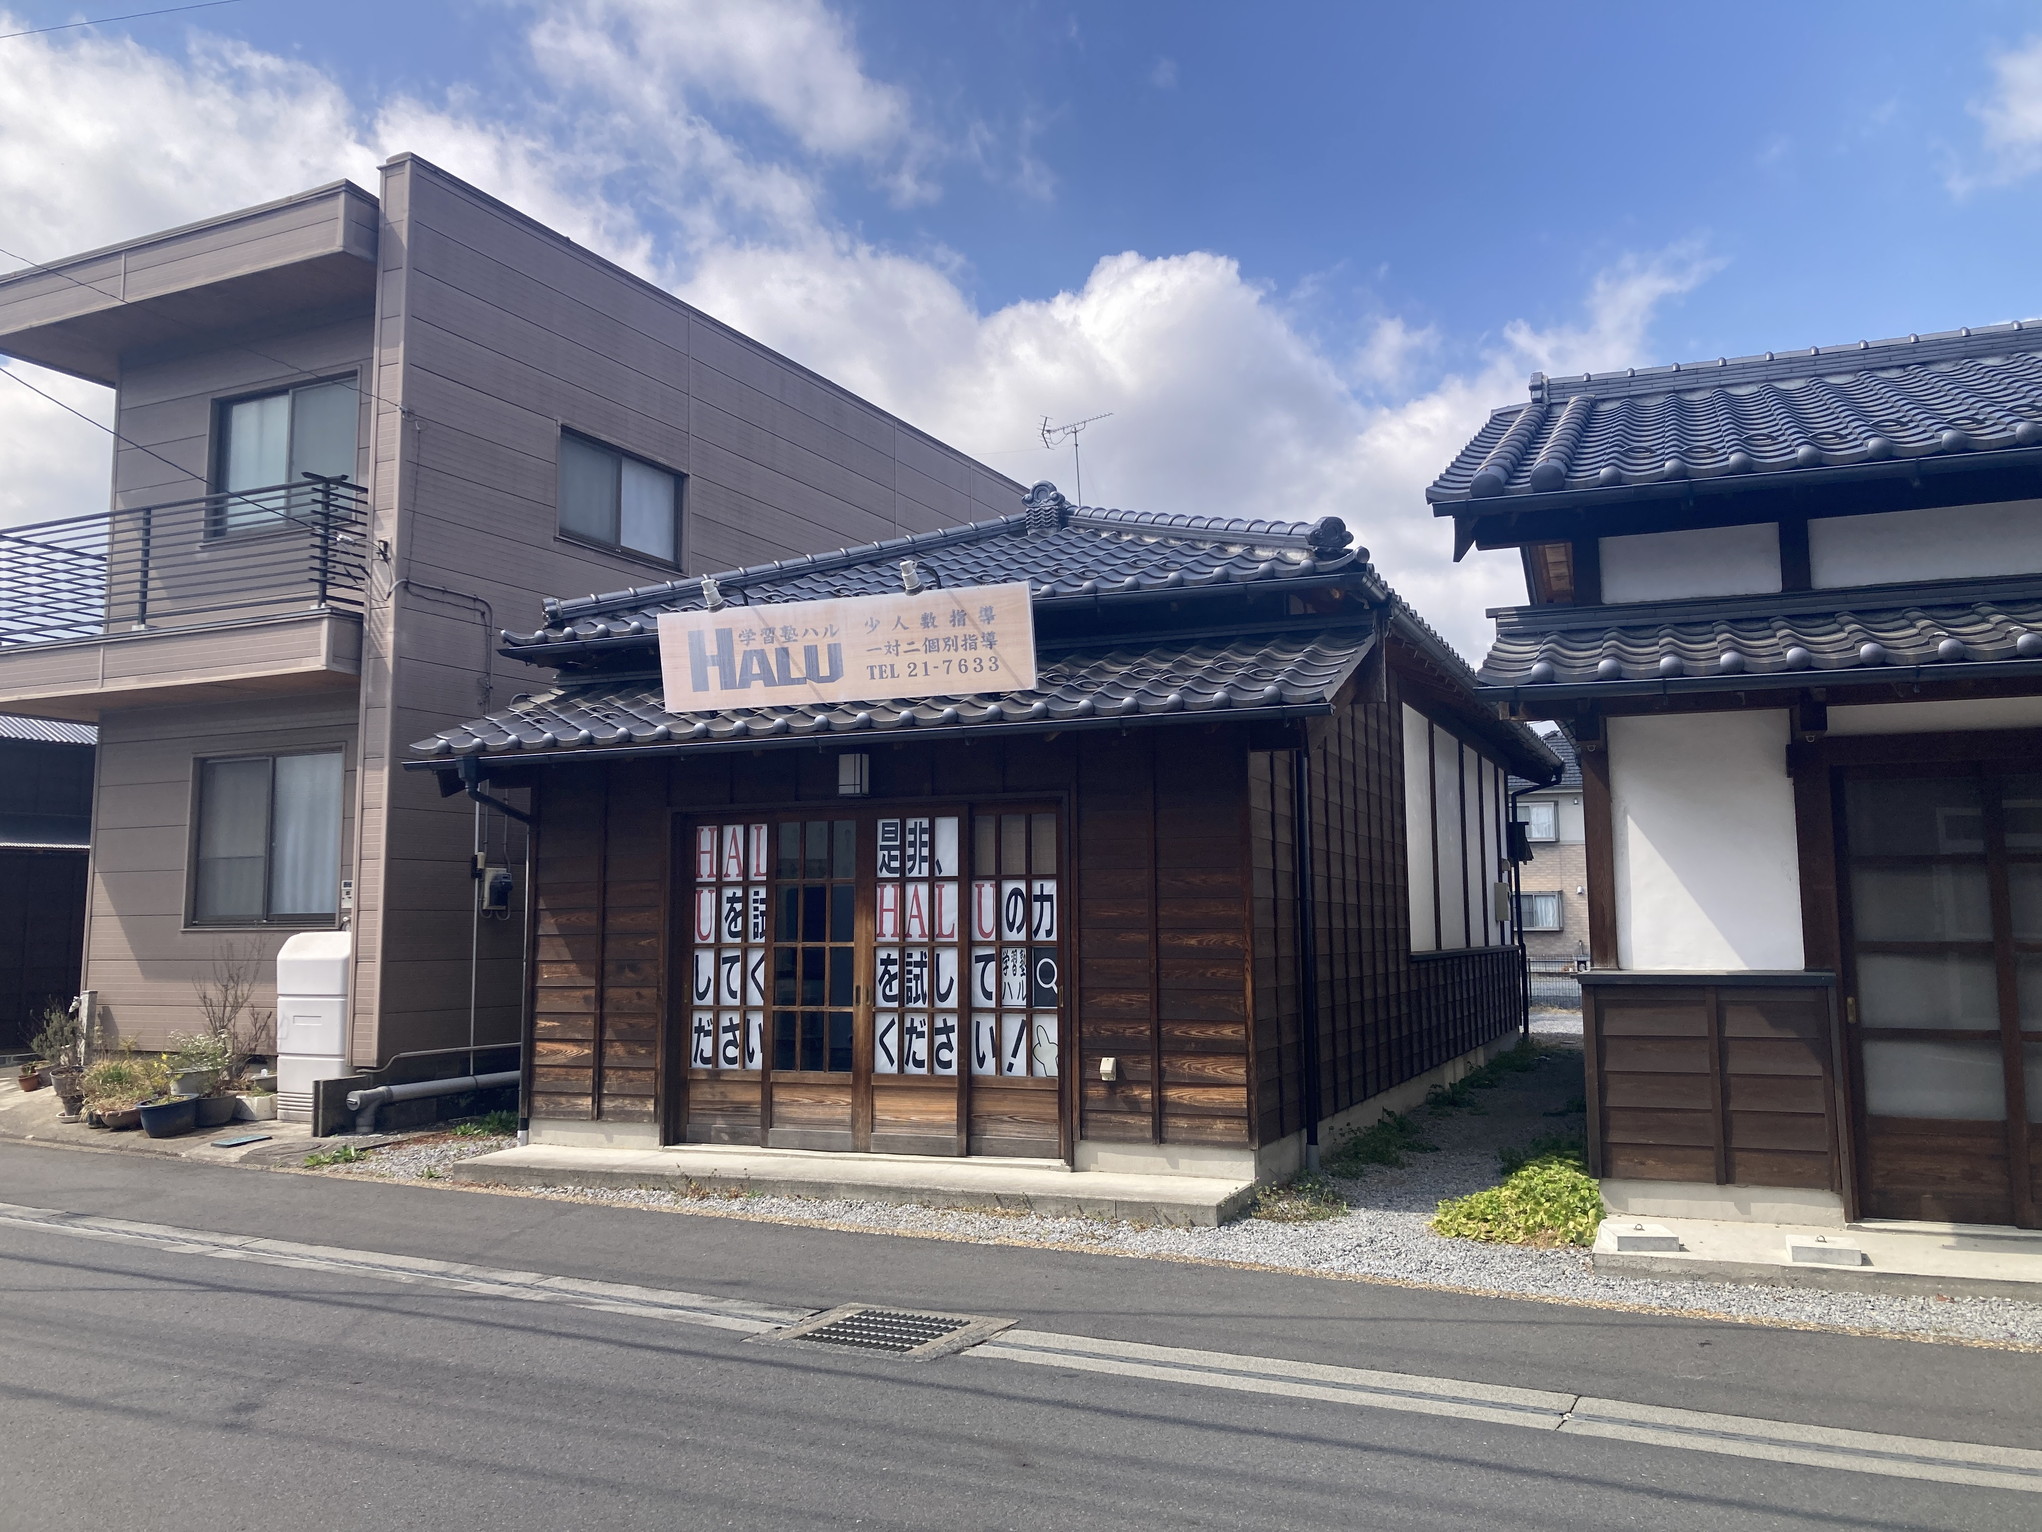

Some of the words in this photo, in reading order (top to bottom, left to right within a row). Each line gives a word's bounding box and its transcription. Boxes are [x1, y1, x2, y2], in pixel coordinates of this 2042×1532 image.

[738, 624, 840, 646] 学習塾ハル
[866, 631, 998, 657] 一対二個別指導
[688, 628, 844, 692] HALU
[866, 663, 900, 680] TEL
[907, 656, 1000, 677] 21-7633
